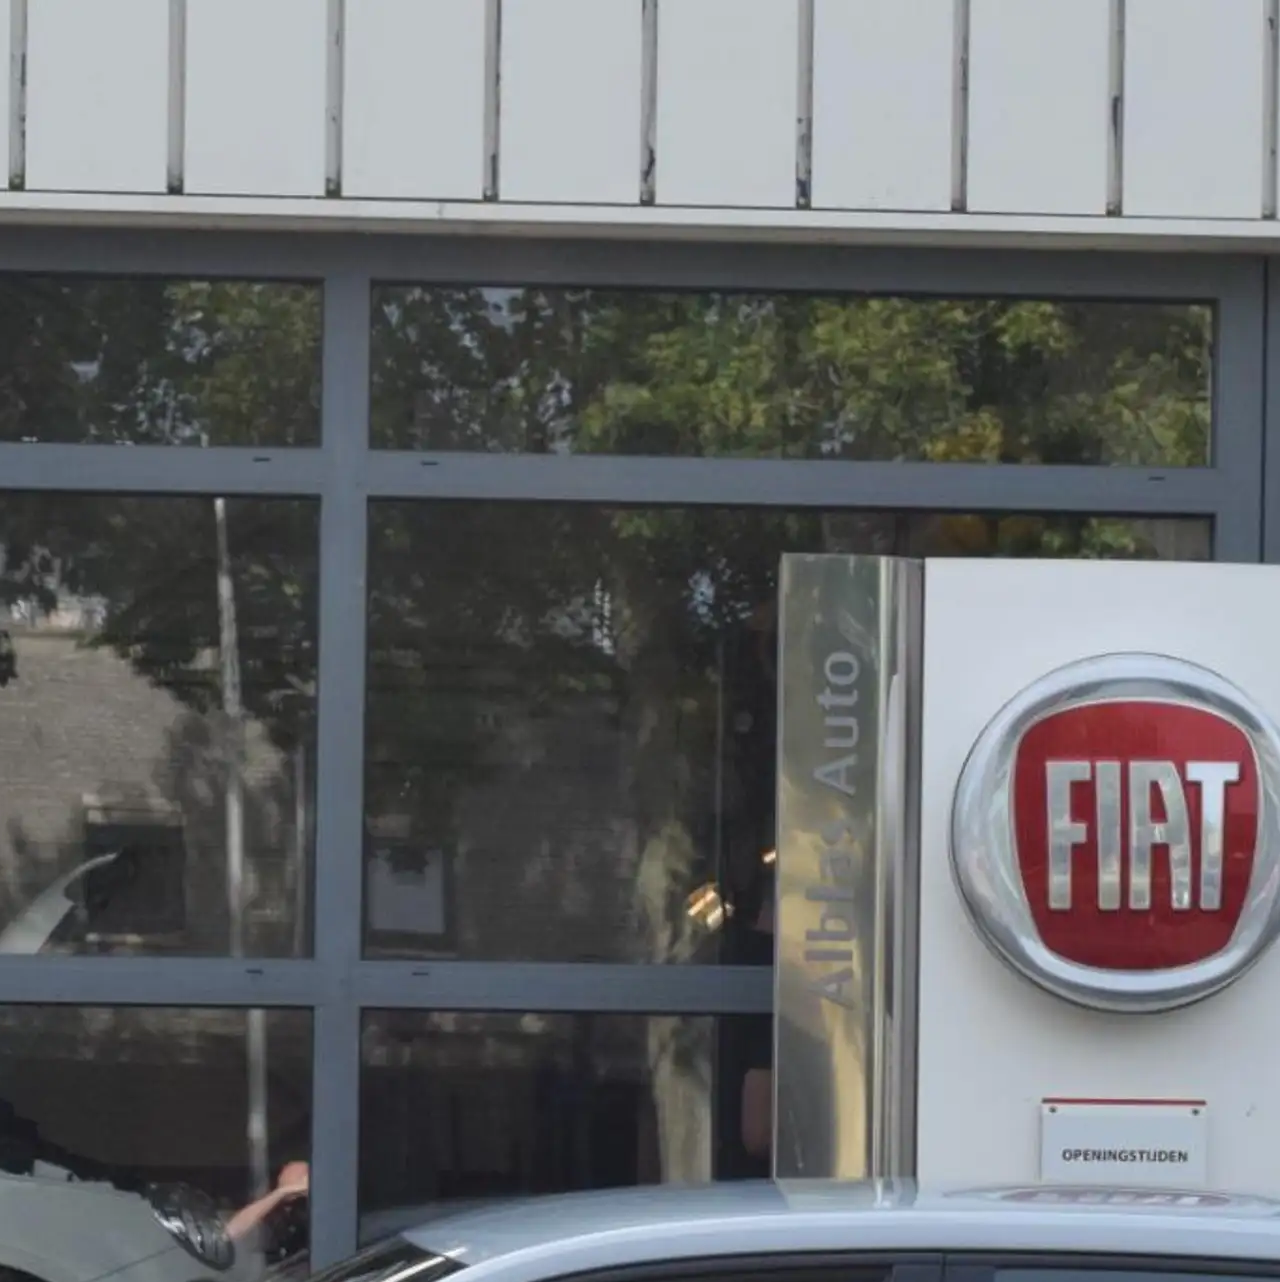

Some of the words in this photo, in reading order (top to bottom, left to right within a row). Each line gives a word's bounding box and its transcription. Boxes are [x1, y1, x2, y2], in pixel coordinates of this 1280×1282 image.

[812, 650, 860, 798] Auto
[1045, 760, 1241, 912] FIAT
[1061, 1148, 1189, 1164] OPENINGSTIJDEN
